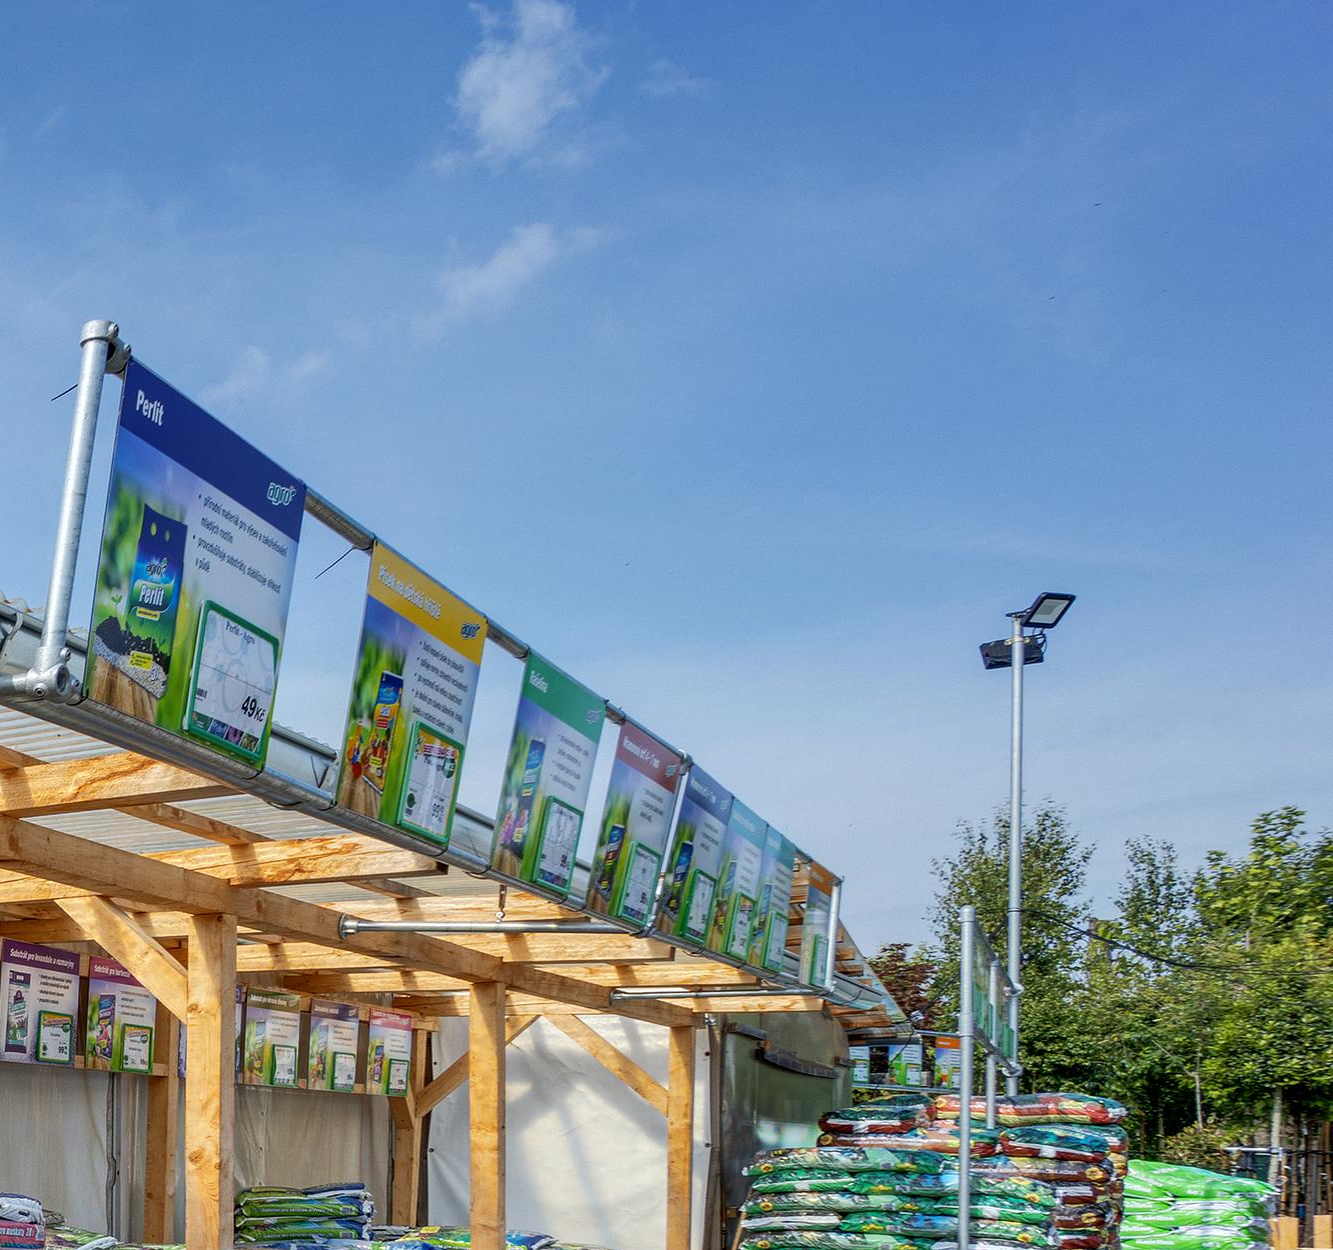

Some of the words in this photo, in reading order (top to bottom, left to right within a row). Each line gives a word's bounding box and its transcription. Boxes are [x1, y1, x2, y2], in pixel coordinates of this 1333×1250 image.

[136, 390, 164, 425] Perlit
[139, 584, 165, 606] Perlit
[241, 696, 256, 717] 49
[256, 709, 265, 722] Kč
[10, 949, 27, 959] Substrát
